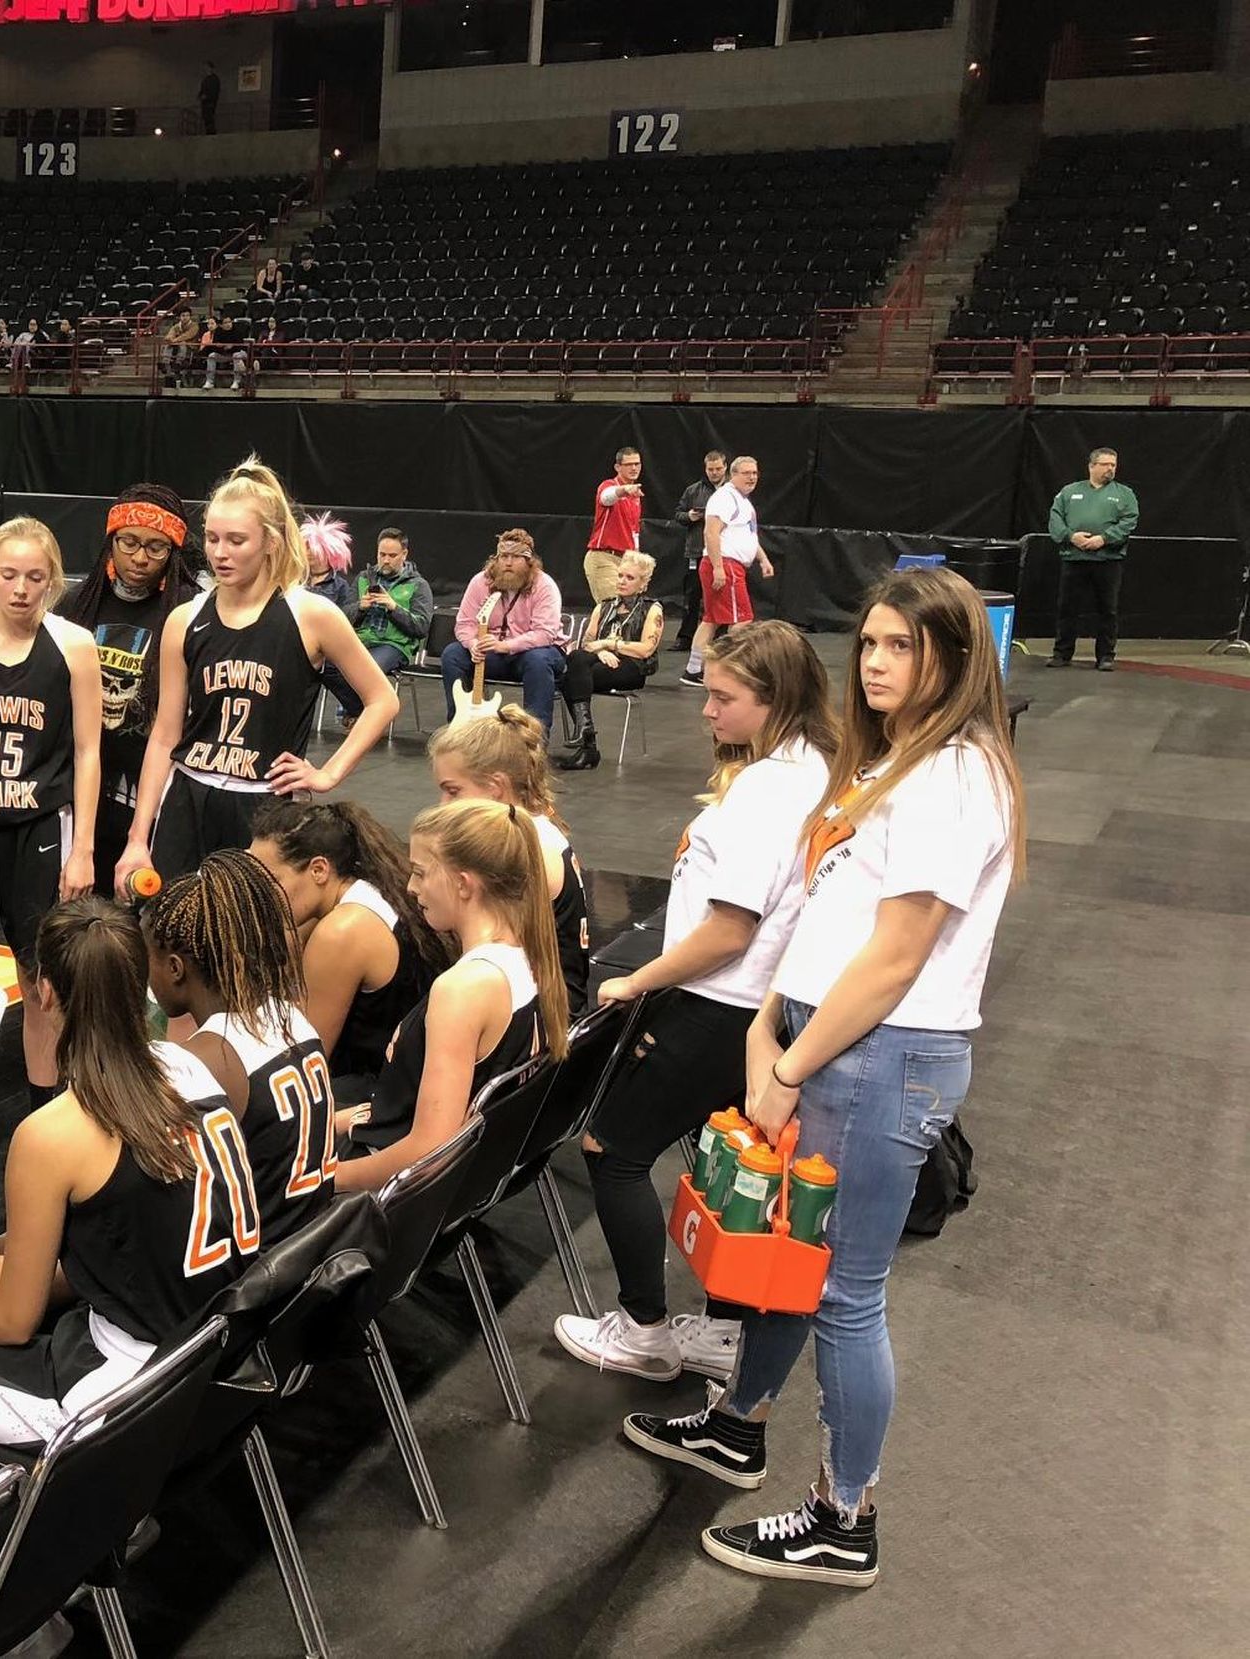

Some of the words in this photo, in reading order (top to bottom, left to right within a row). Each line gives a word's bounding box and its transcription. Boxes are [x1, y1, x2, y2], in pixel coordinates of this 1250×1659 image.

[616, 113, 679, 153] 122
[22, 142, 76, 176] 123
[203, 659, 273, 697] LEWIS
[217, 696, 251, 746] 12
[184, 741, 260, 779] CLARK
[269, 1051, 339, 1199] 22
[183, 1107, 261, 1278] 20
